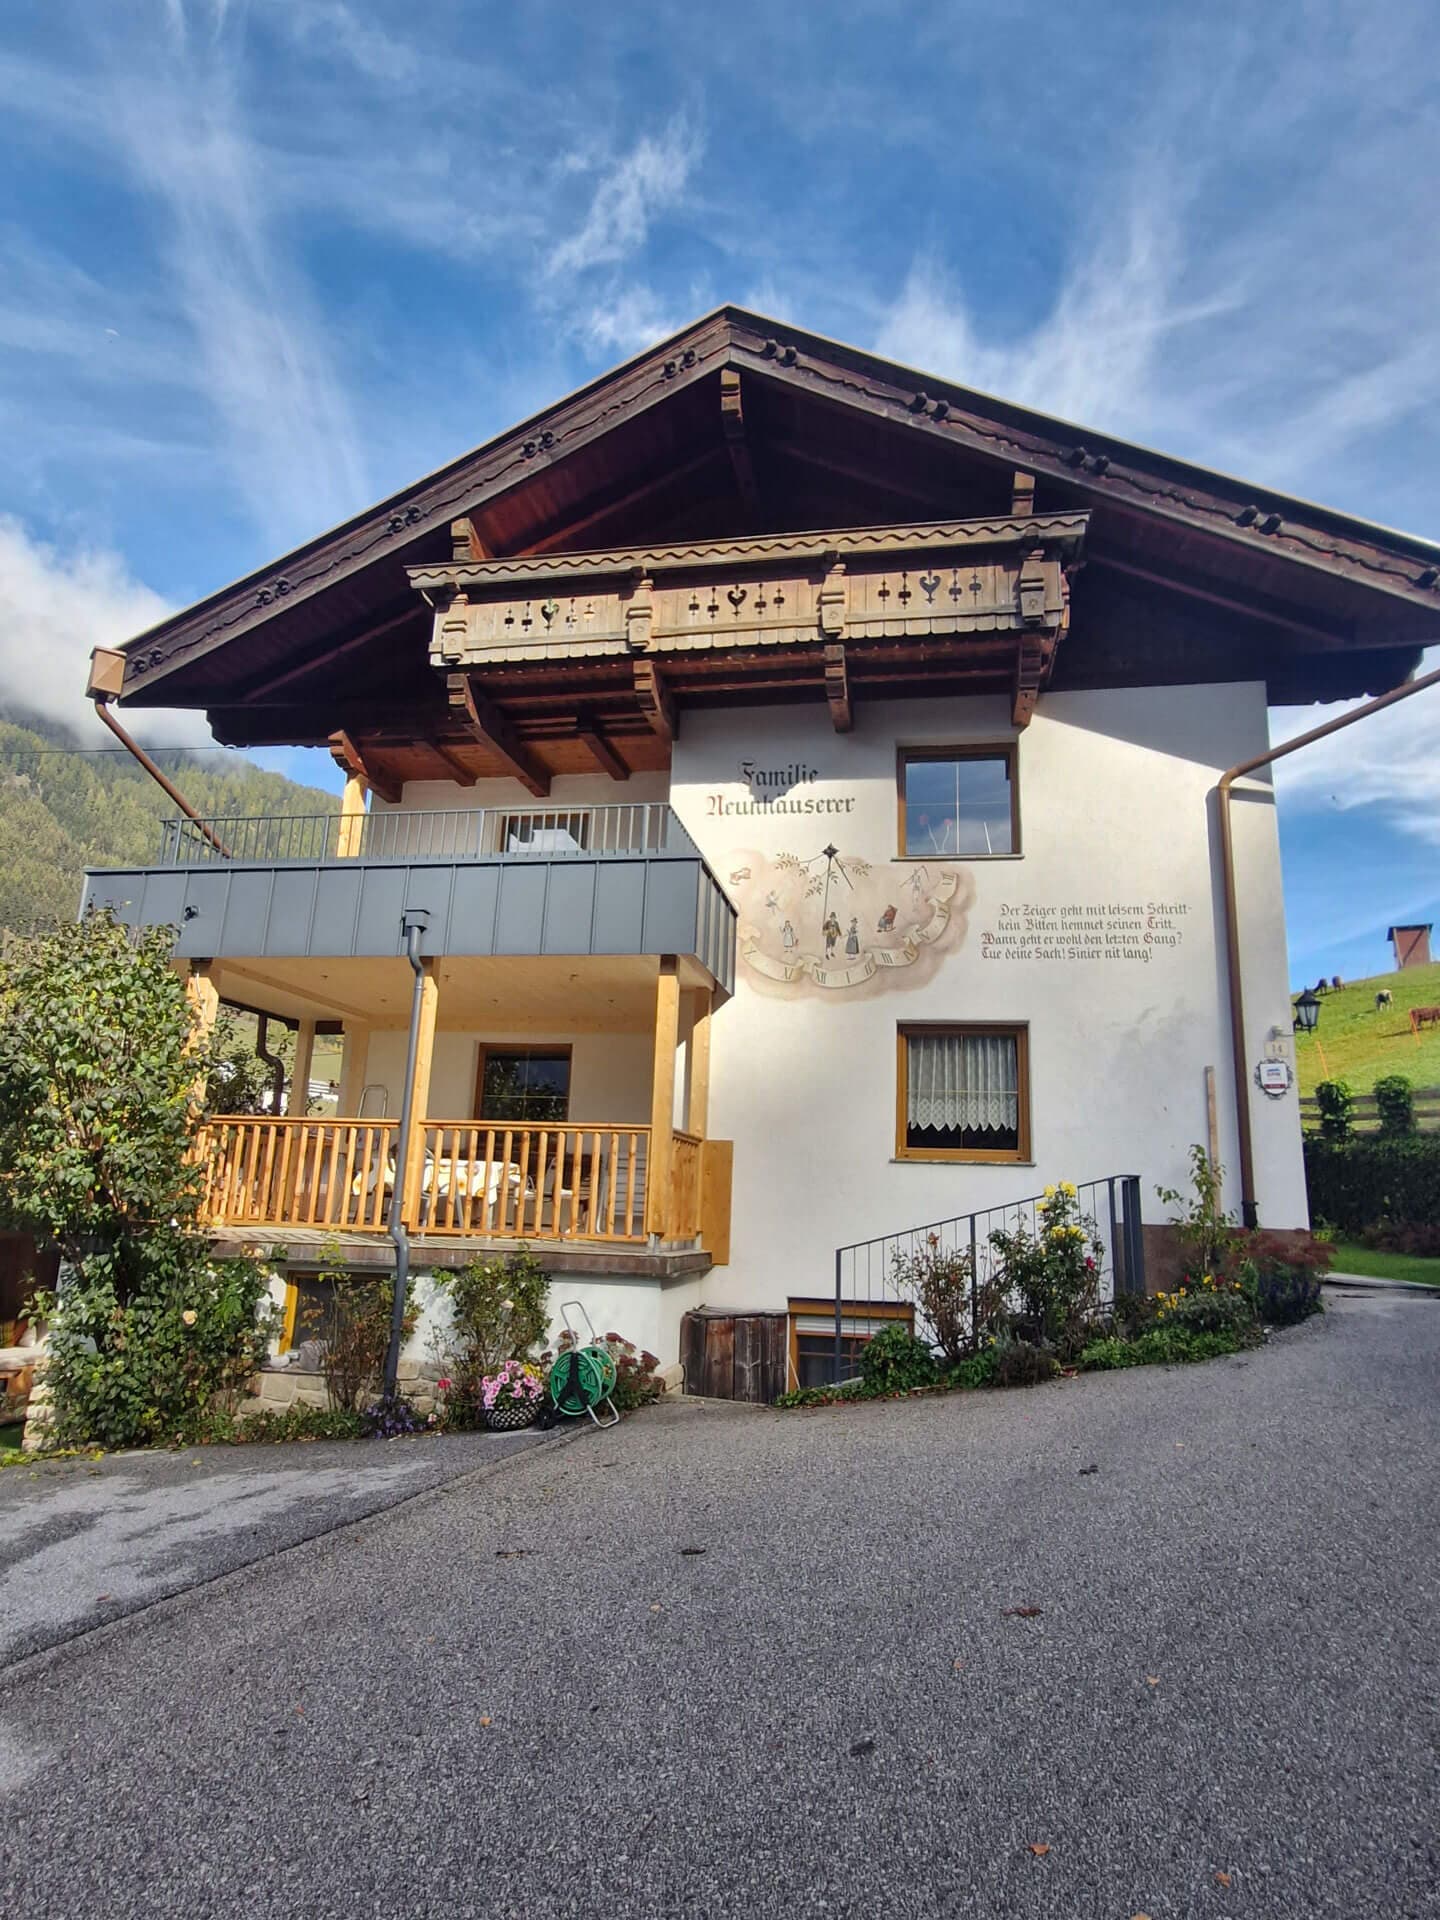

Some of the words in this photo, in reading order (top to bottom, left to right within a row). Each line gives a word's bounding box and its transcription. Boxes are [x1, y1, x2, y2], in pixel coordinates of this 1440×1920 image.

[740, 761, 819, 786] Familie
[1000, 904, 1020, 916] Der
[1022, 904, 1057, 919] Zeiger
[1060, 904, 1083, 918] geht
[1086, 903, 1106, 915] mit
[1108, 903, 1144, 916] leisem
[998, 919, 1021, 930] kein
[1025, 918, 1058, 931] Bitten
[1061, 918, 1104, 930] hemmet
[1106, 918, 1142, 930] seinen
[981, 932, 1017, 945] Wann
[1019, 934, 1042, 947] geht
[1043, 936, 1055, 945] er
[1056, 934, 1081, 945] wohl
[1084, 933, 1102, 944] den
[1105, 932, 1139, 945] letzten
[1143, 931, 1183, 947] Gang?
[981, 947, 1002, 959] Tue
[1005, 947, 1033, 959] deine
[1034, 946, 1065, 960] Sach!
[1105, 946, 1120, 959] nit
[1123, 946, 1153, 962] lang!
